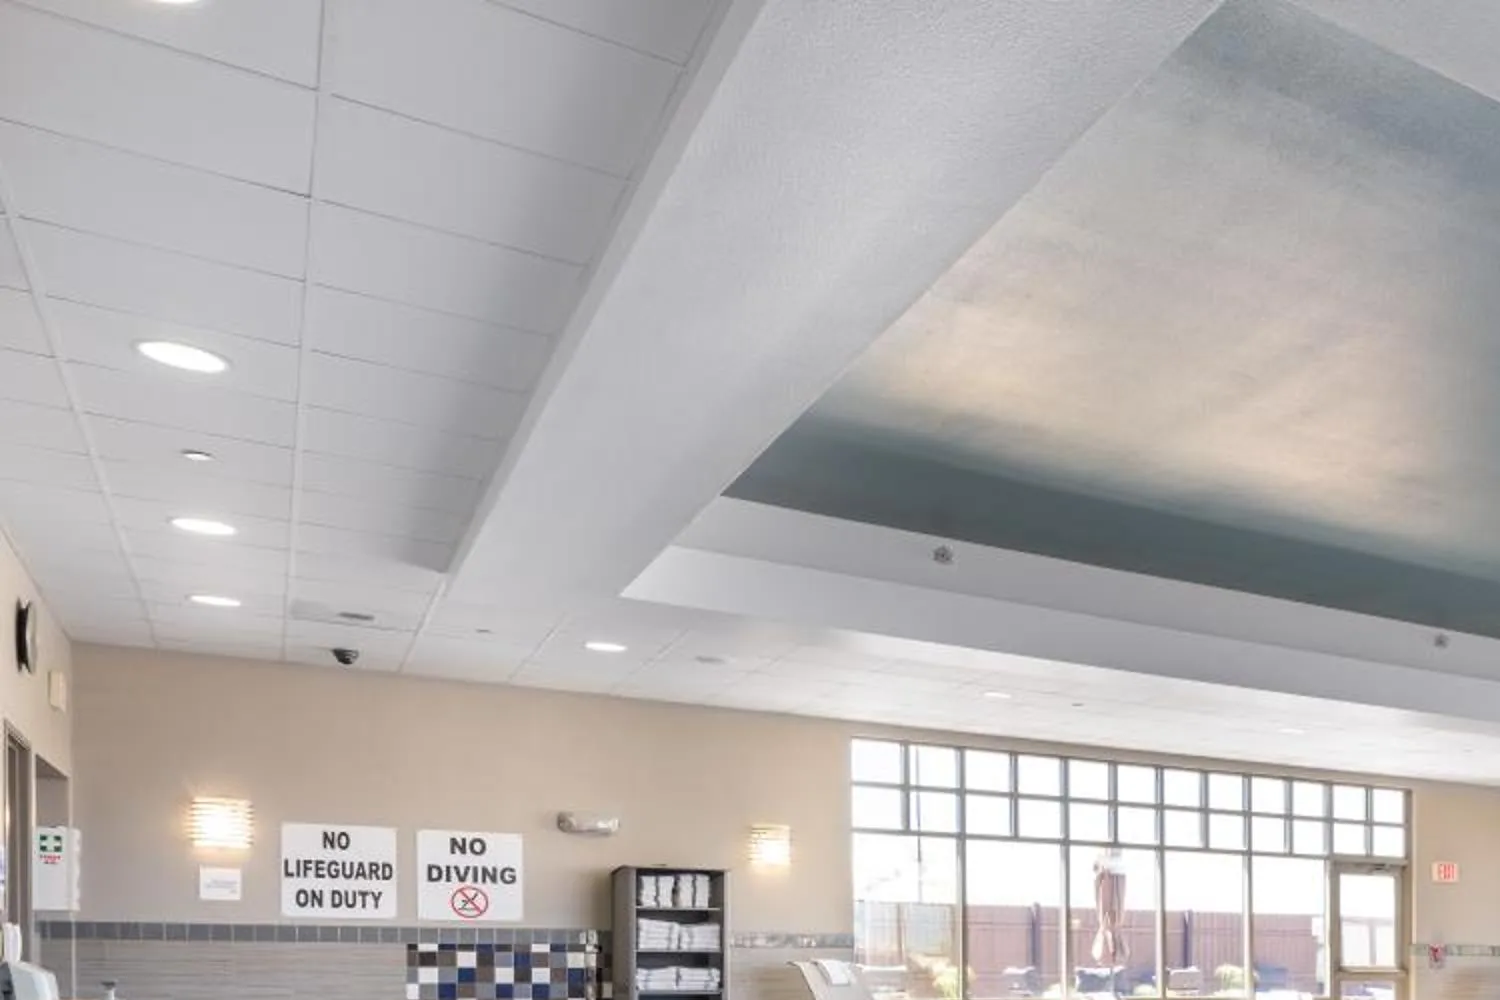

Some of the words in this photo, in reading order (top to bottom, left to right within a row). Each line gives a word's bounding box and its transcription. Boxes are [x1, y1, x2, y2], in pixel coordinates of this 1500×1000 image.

[322, 831, 350, 850] NO
[450, 837, 486, 856] NO
[284, 859, 393, 881] LIFEGUARD
[427, 864, 517, 885] DIVING
[295, 889, 323, 908] ON
[331, 889, 383, 909] DUTY
